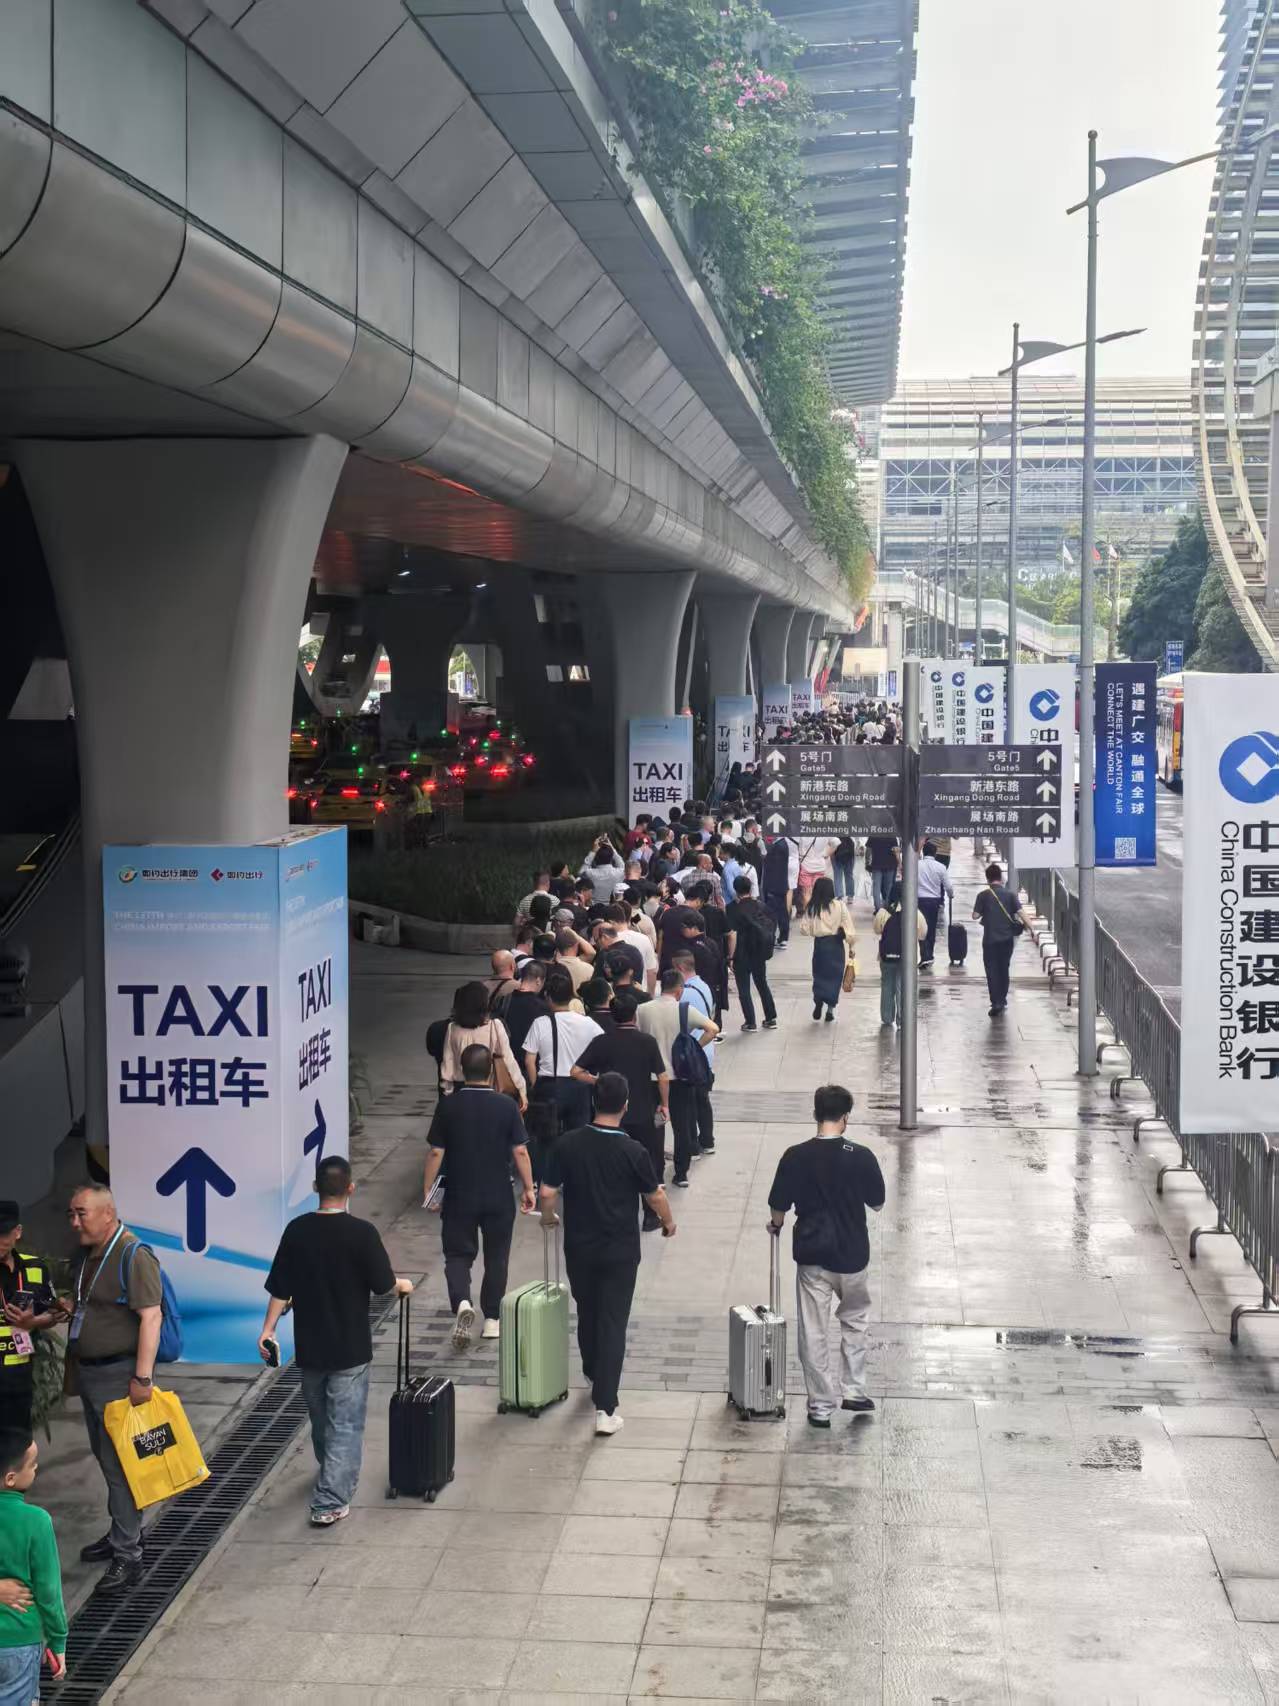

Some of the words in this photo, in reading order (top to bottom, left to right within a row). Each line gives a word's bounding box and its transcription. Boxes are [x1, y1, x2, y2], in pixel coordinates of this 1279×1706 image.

[1115, 683, 1124, 709] LET'S
[765, 705, 788, 714] TAXI
[1107, 683, 1115, 729] CONNECT
[1115, 711, 1123, 735] MEET
[1115, 737, 1123, 750] AT
[800, 751, 832, 763] 5号门
[988, 751, 1020, 763] 5号门
[633, 763, 683, 780] TAXI
[800, 764, 826, 772] Gate5
[994, 764, 1020, 772] Gate5
[1115, 752, 1123, 790] CANTON
[800, 780, 849, 792] 新港东路
[970, 780, 1020, 792] 新港东路
[1131, 754, 1145, 815] 融通全球
[632, 786, 682, 803] 出租车
[800, 793, 836, 802] Xingang
[838, 793, 861, 802] Dong
[863, 793, 886, 801] Road
[934, 793, 970, 802] Xingang
[972, 793, 995, 802] Dong
[997, 793, 1020, 801] Road
[1115, 793, 1123, 814] FAIR
[800, 810, 848, 822] 展场南路
[970, 811, 1019, 822] 展场南路
[800, 825, 849, 834] Zhanchang
[851, 826, 869, 834] Nan
[925, 826, 975, 835] Zhanchang
[977, 826, 994, 834] Nan
[1220, 821, 1240, 884] China
[1219, 889, 1239, 1021] Construction
[1236, 820, 1279, 1080] 中国建设银行
[298, 958, 331, 1023] TAXI
[117, 985, 269, 1037] TAXI
[298, 1027, 331, 1091] 出租车
[1219, 1025, 1237, 1079] Bank
[119, 1056, 269, 1108] 出租车
